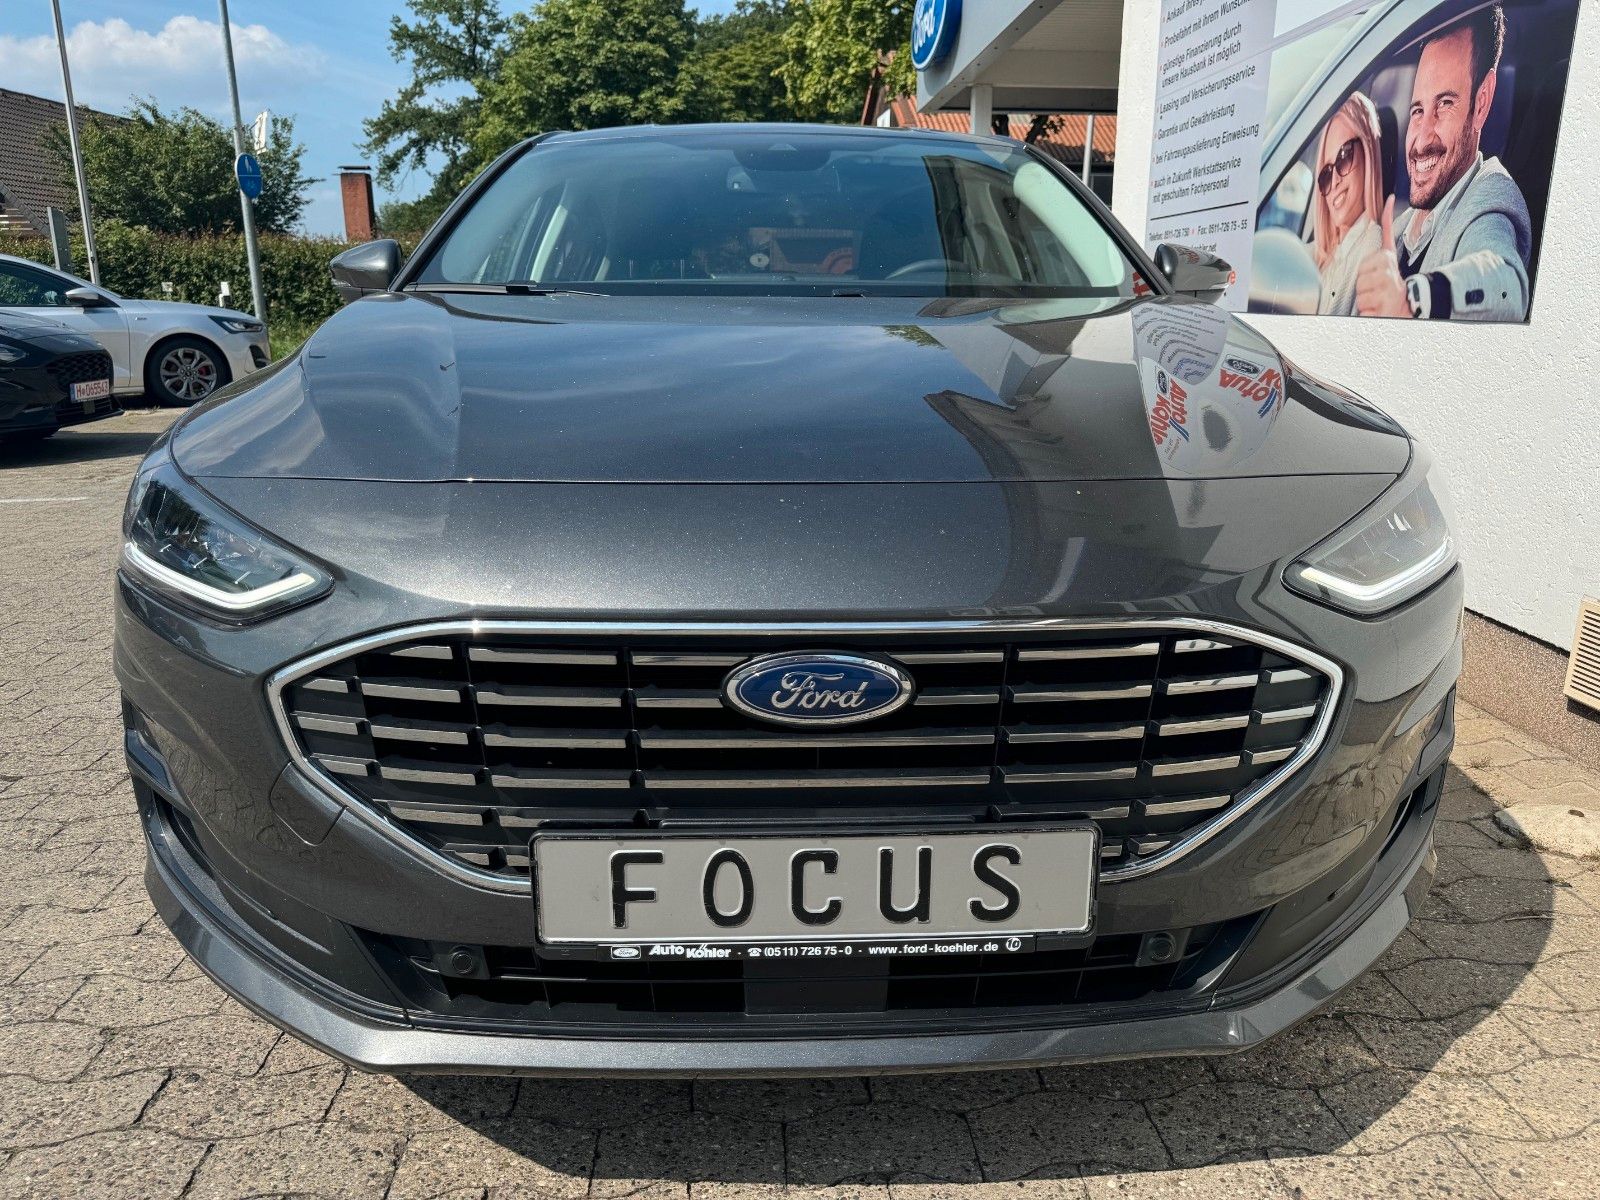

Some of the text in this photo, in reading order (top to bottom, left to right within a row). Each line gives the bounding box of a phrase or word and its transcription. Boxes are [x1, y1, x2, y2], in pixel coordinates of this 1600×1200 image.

[1163, 21, 1241, 74] günstige Finanzierung durch
[1165, 25, 1191, 47] Probefahrt
[1192, 17, 1201, 32] mit
[1202, 10, 1219, 27] ihrem
[1162, 40, 1241, 88] unsere Hausbank ist möglich
[1160, 64, 1255, 114] Leasing und Versicherungsservice
[1158, 104, 1235, 140] Garantie und Gewährleistung
[1164, 136, 1220, 162] Fahrzeugauslieferung
[1222, 123, 1259, 144] Einweisung
[1154, 177, 1165, 188] auch
[1172, 169, 1192, 184] Zukunft
[1192, 156, 1241, 178] Werkstattservice
[1161, 185, 1190, 204] geschultem
[1191, 175, 1229, 195] Fachpersonal
[771, 671, 869, 709] Ford
[610, 844, 1022, 928] FOCUS
[649, 944, 685, 956] Auto
[686, 943, 731, 958] Köhler
[800, 946, 822, 957] 726
[868, 941, 999, 955] www.ford-koehler.de
